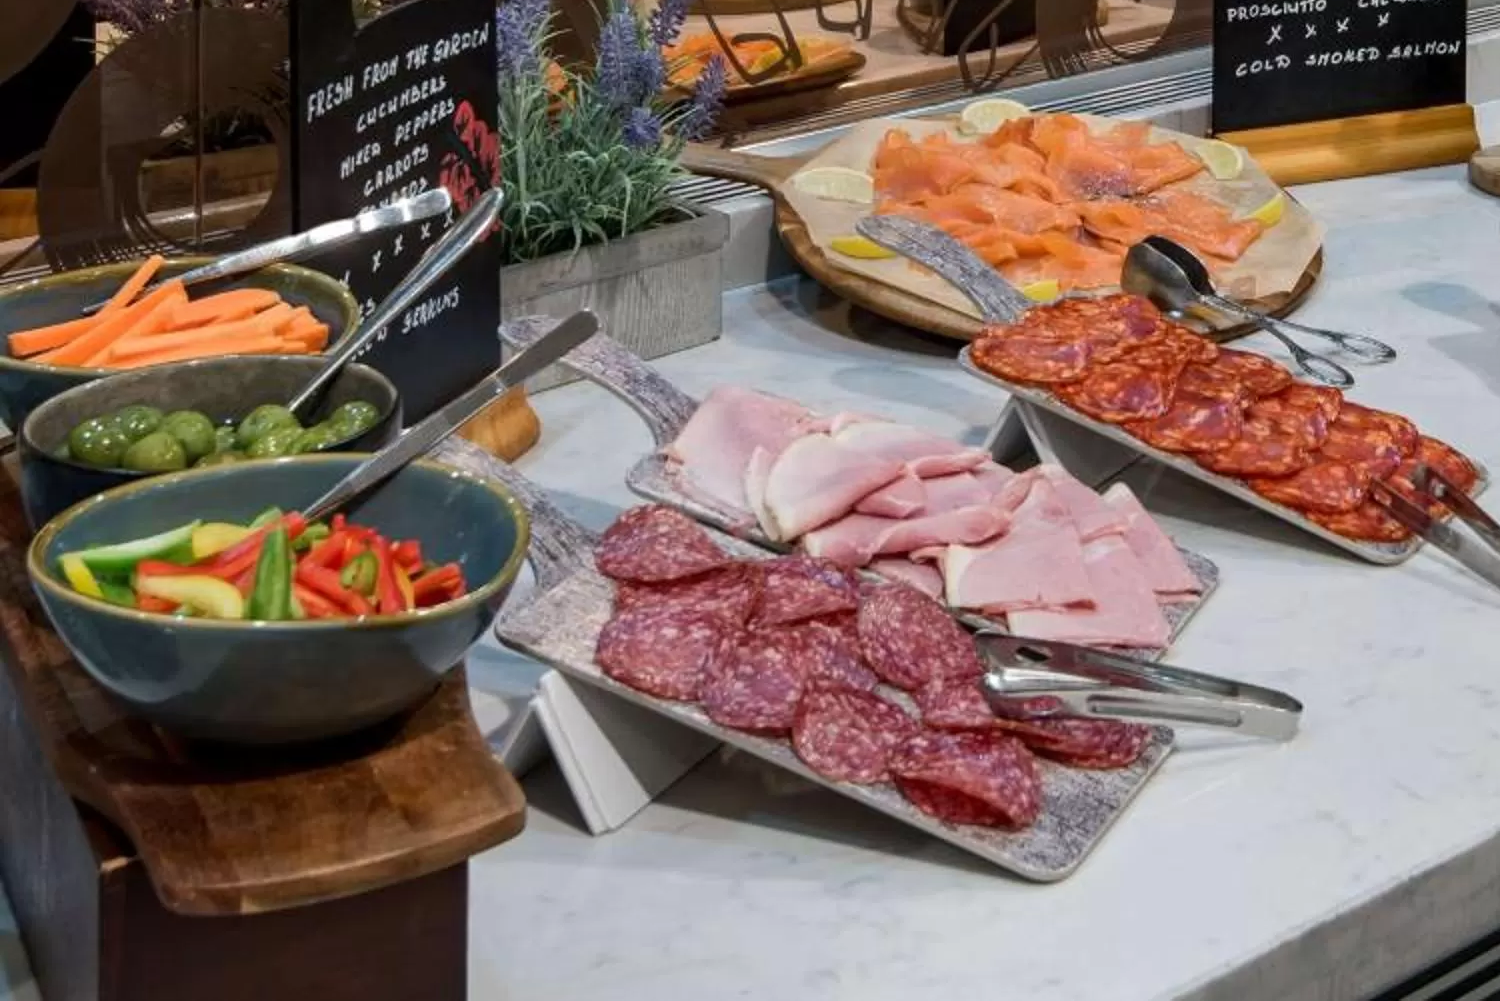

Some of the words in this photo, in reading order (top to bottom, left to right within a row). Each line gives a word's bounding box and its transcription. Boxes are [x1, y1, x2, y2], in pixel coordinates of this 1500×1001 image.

[307, 75, 353, 122] FRESH
[363, 55, 398, 89] FROM
[406, 44, 429, 69] THE
[432, 23, 488, 62] GARDEN
[1236, 55, 1290, 77] COLD
[1305, 47, 1379, 66] SMOKED
[1388, 41, 1460, 59] SALMON
[356, 75, 448, 132] CUCUMBERS
[340, 142, 381, 180] MIXED
[394, 97, 455, 146] PEPPERS
[363, 143, 429, 197] CARROTS
